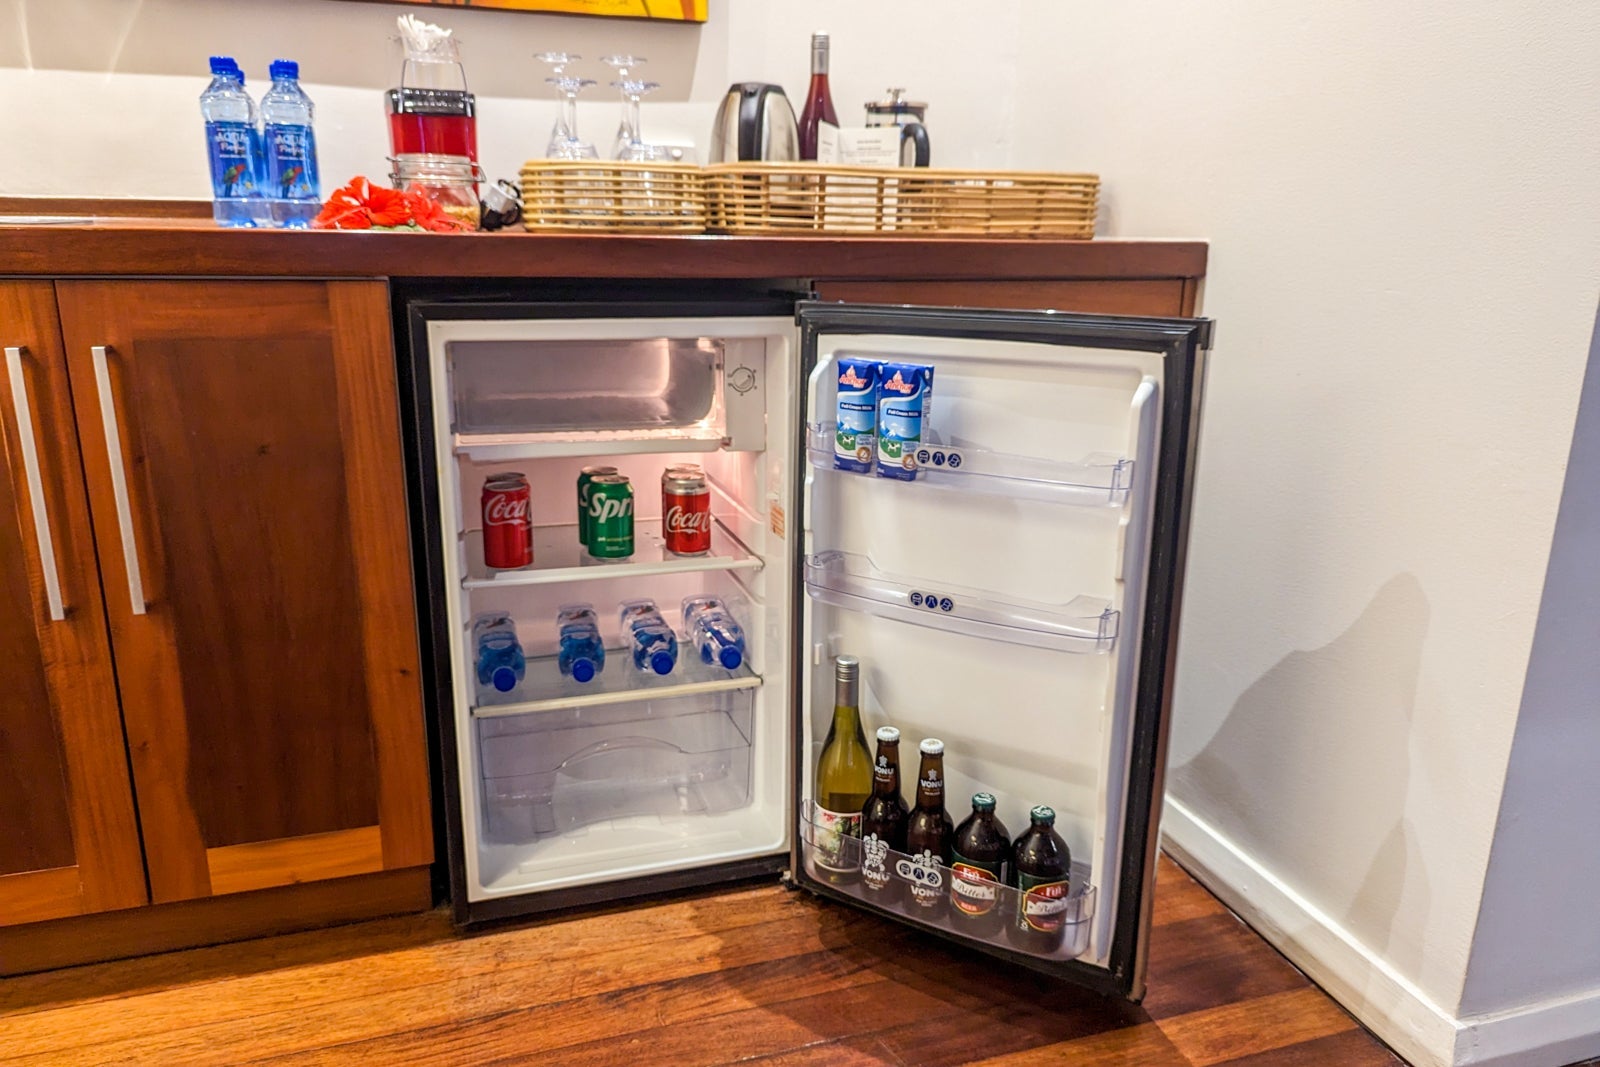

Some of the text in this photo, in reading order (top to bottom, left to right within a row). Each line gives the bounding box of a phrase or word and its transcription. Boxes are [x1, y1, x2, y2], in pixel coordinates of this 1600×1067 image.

[921, 779, 943, 788] VONU
[862, 866, 890, 881] VONU
[911, 885, 943, 897] VONU
